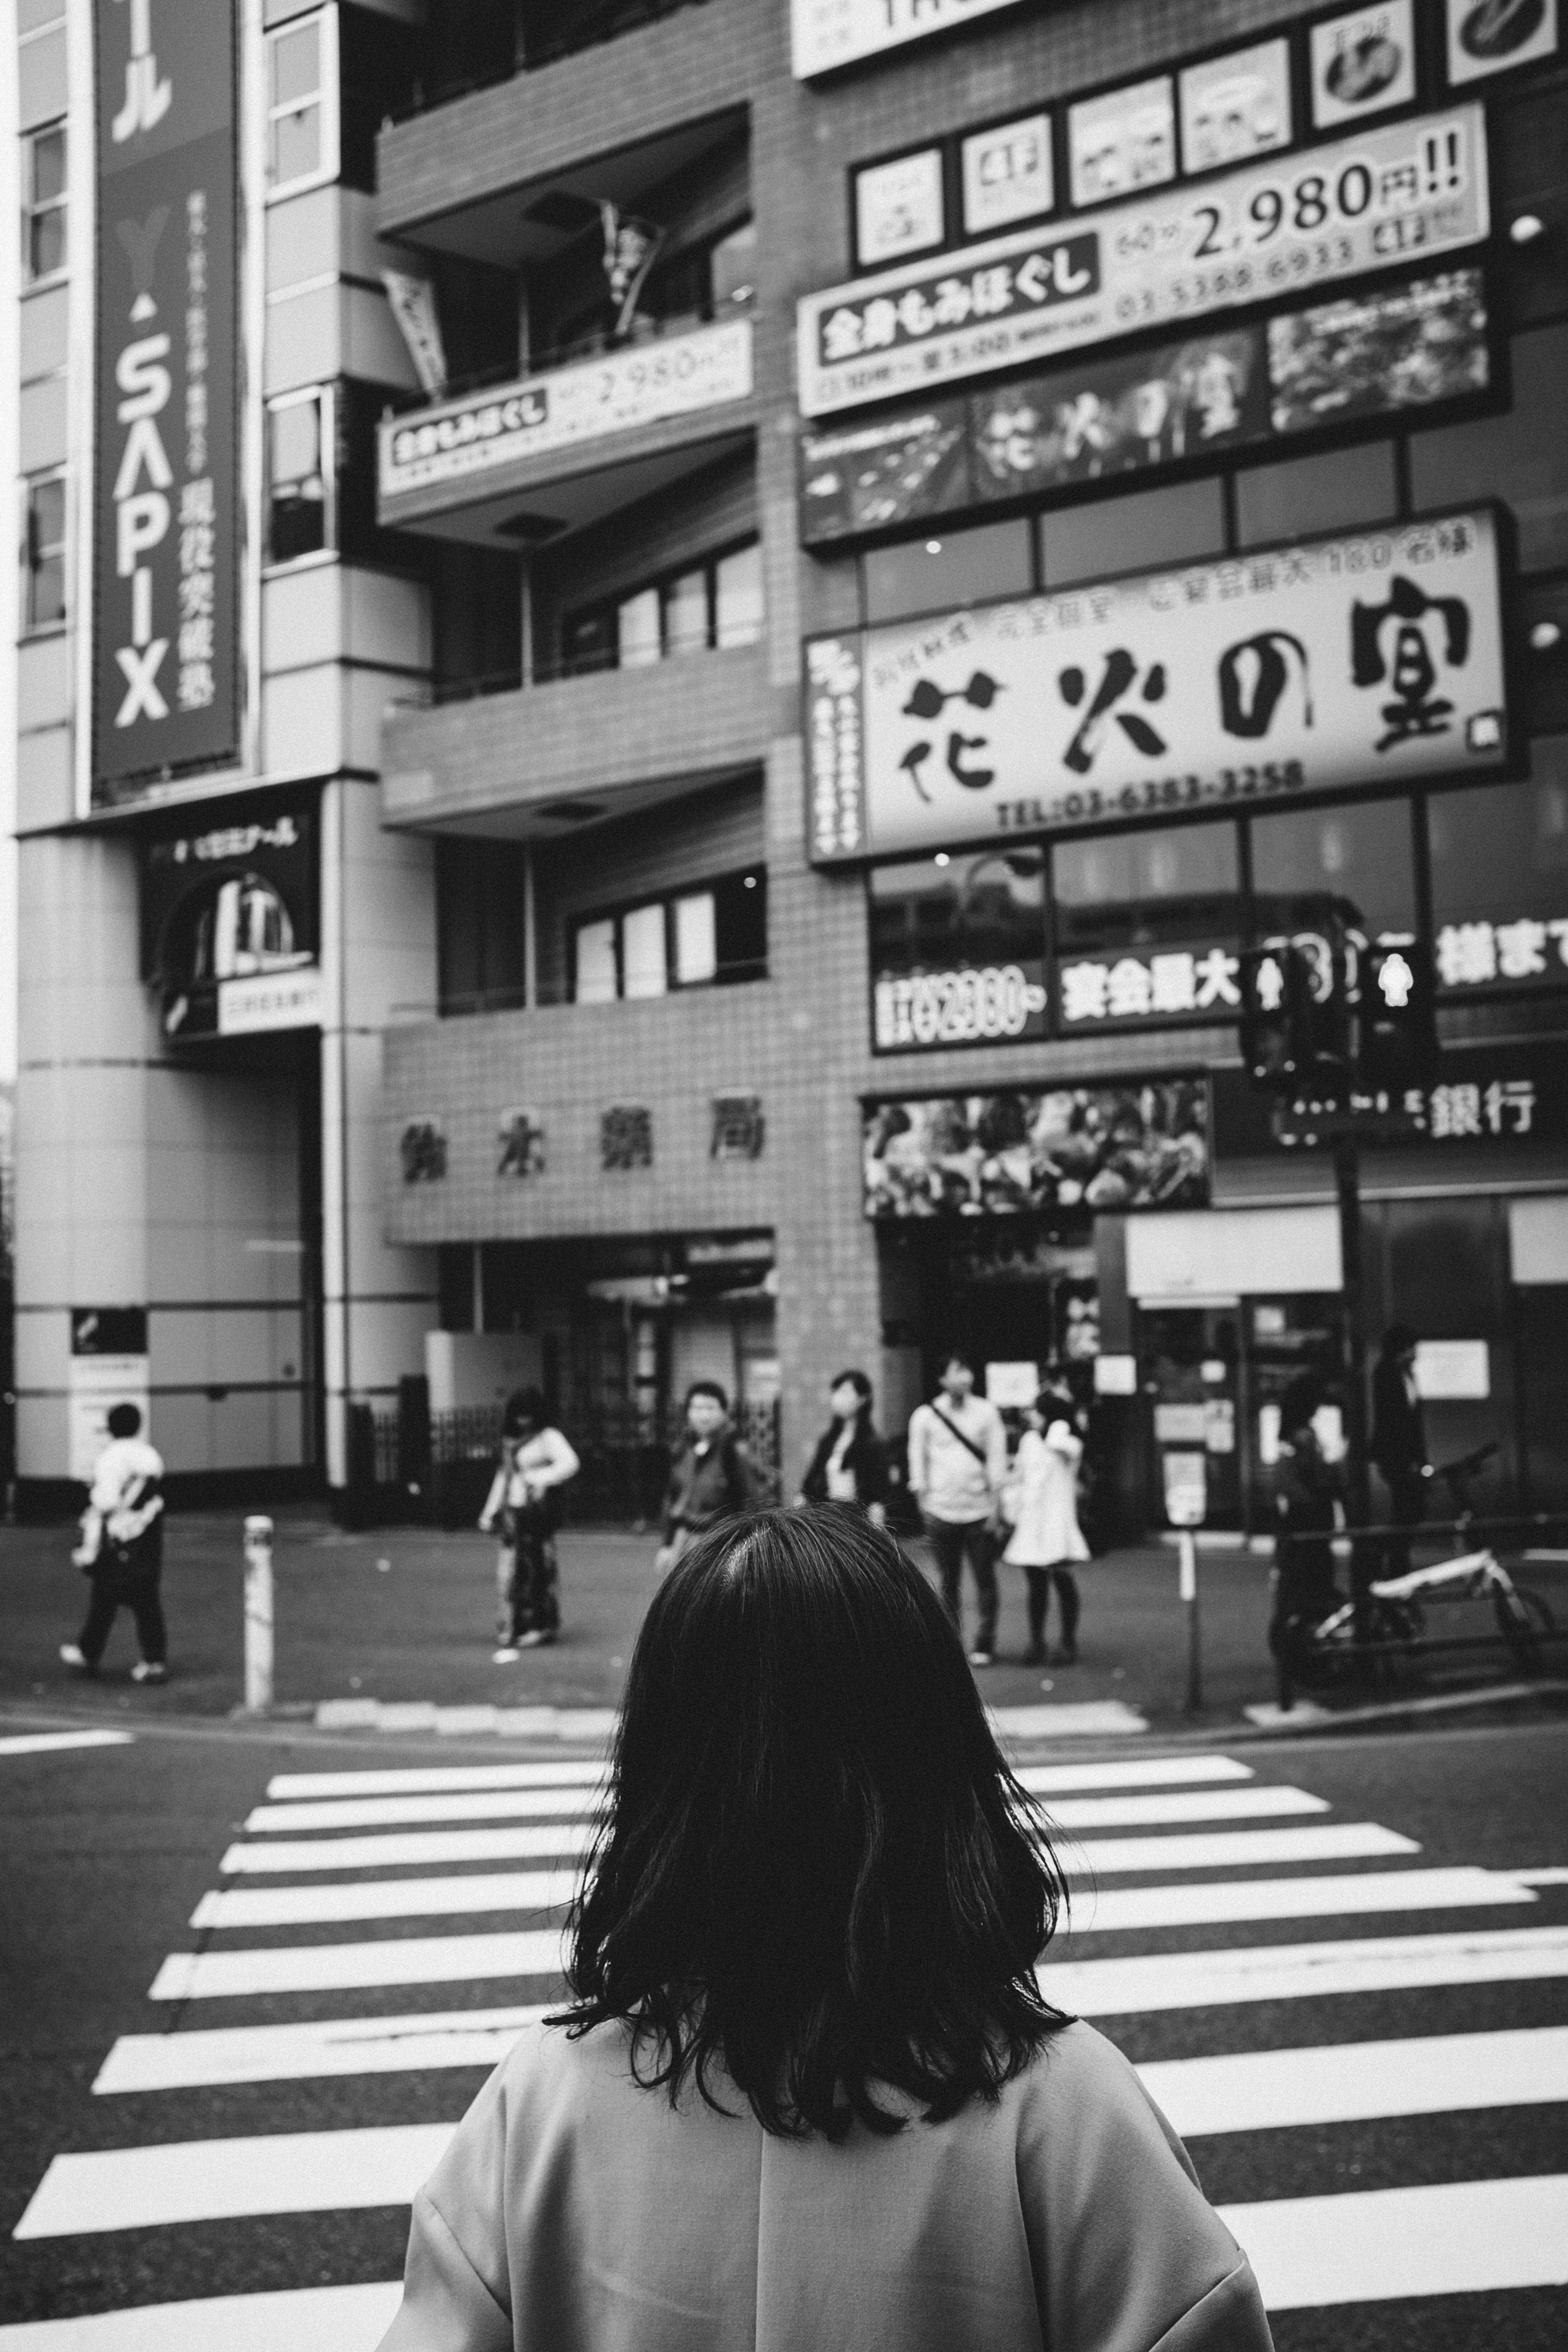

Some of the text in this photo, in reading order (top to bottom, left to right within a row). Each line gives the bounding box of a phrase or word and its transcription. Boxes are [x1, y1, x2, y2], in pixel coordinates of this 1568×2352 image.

[824, 247, 1091, 360] 全身もみほぐし
